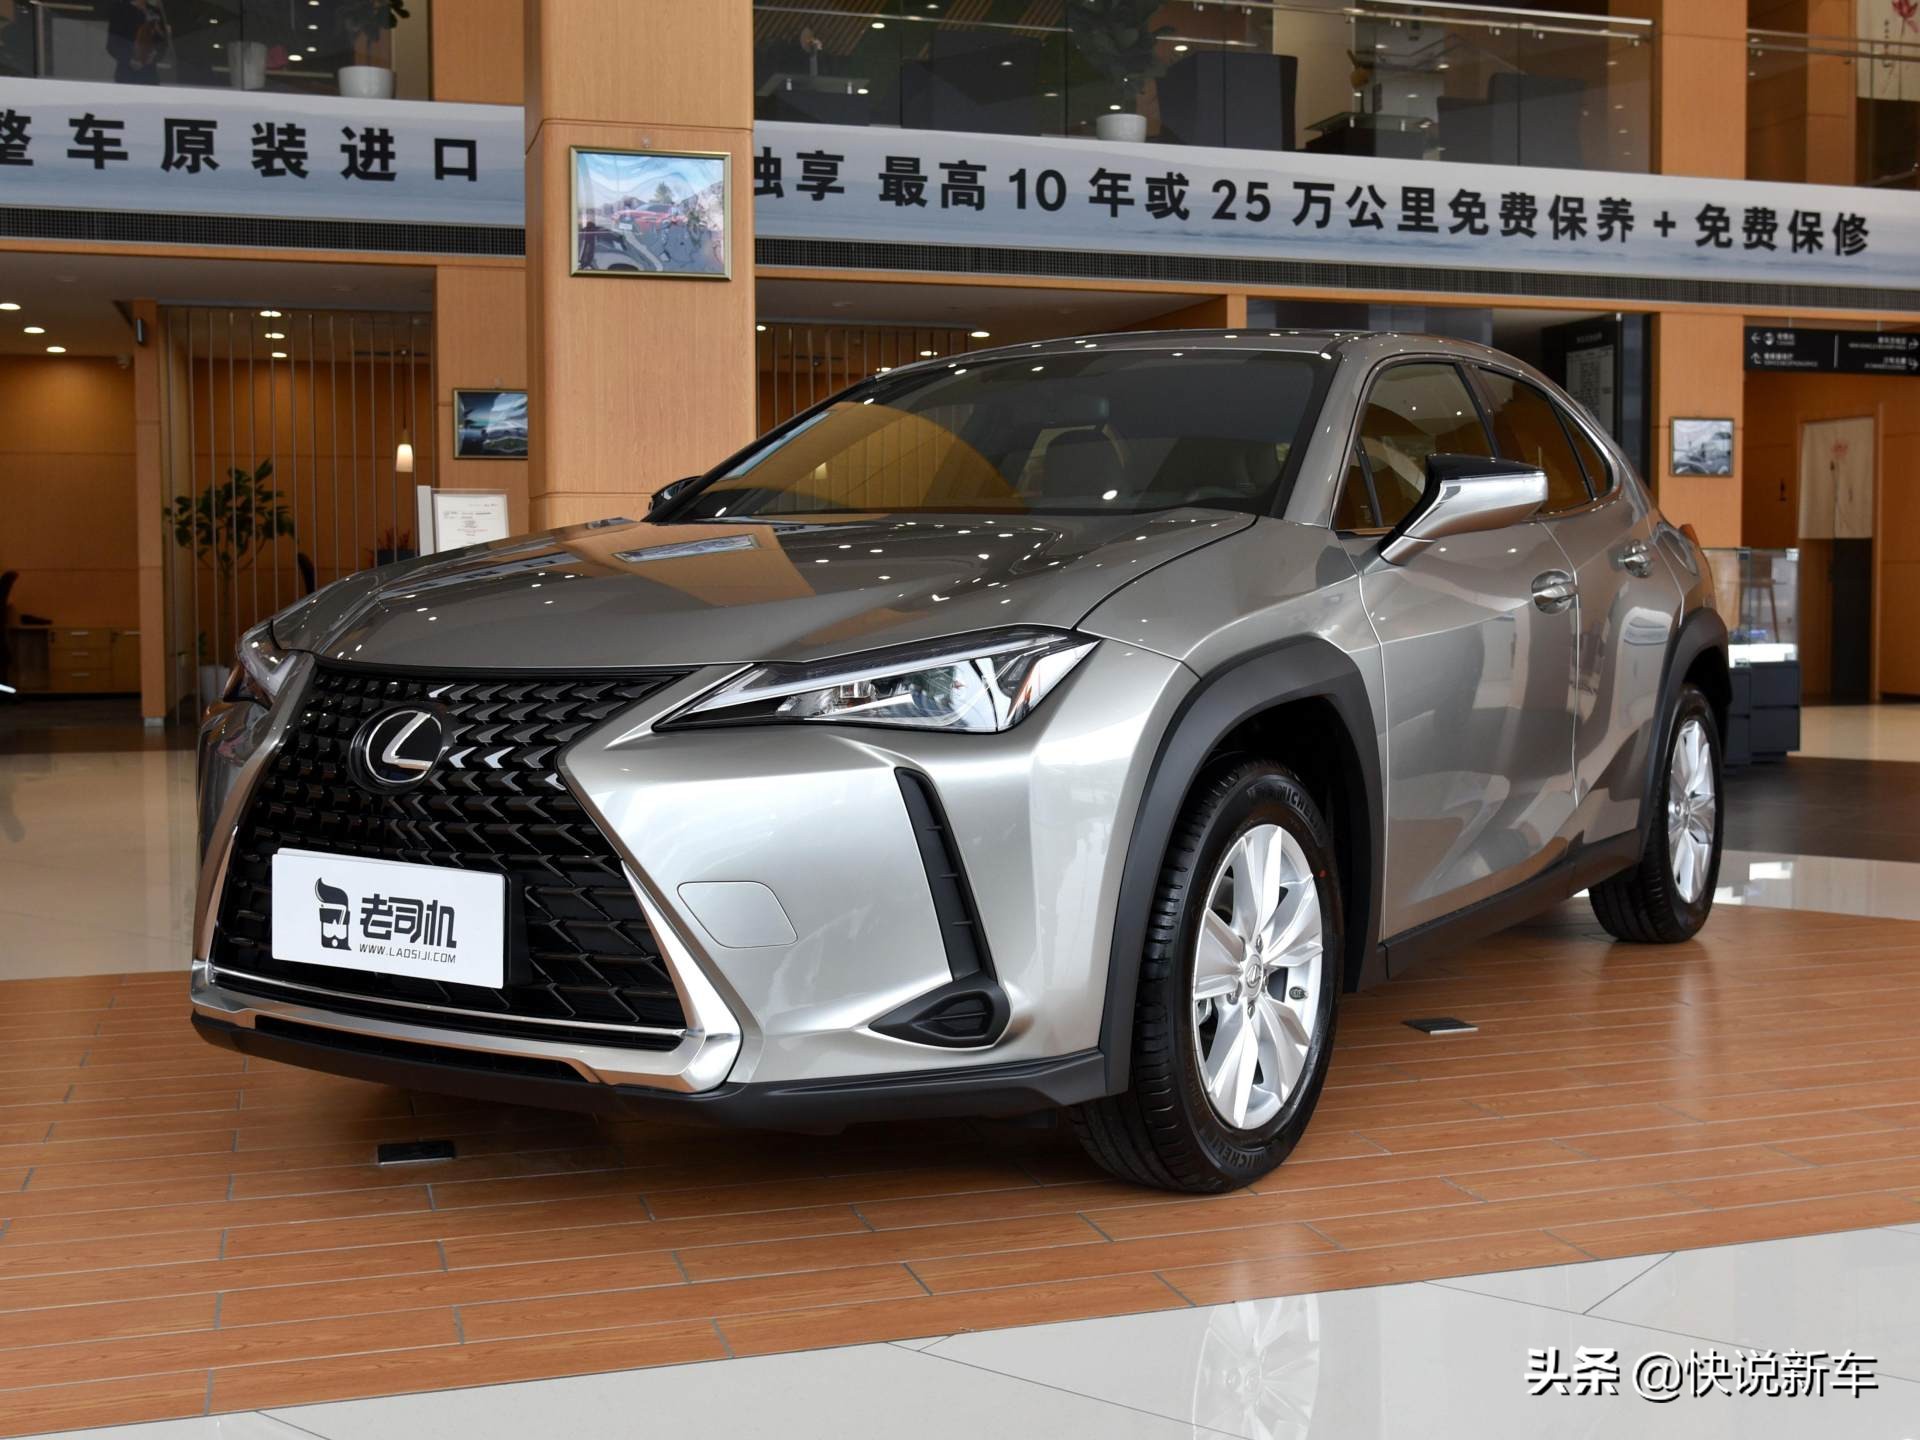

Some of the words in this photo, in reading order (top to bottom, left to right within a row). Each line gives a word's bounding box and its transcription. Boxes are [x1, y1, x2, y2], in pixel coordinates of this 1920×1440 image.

[878, 155, 987, 211] 最高
[1008, 168, 1067, 212] 10
[1088, 167, 1190, 220] 年或
[1211, 179, 1272, 223] 25
[1694, 203, 1870, 256] 免费保修
[360, 893, 457, 949] 老司机
[359, 943, 456, 964] WWW.LAOSIJI.COM
